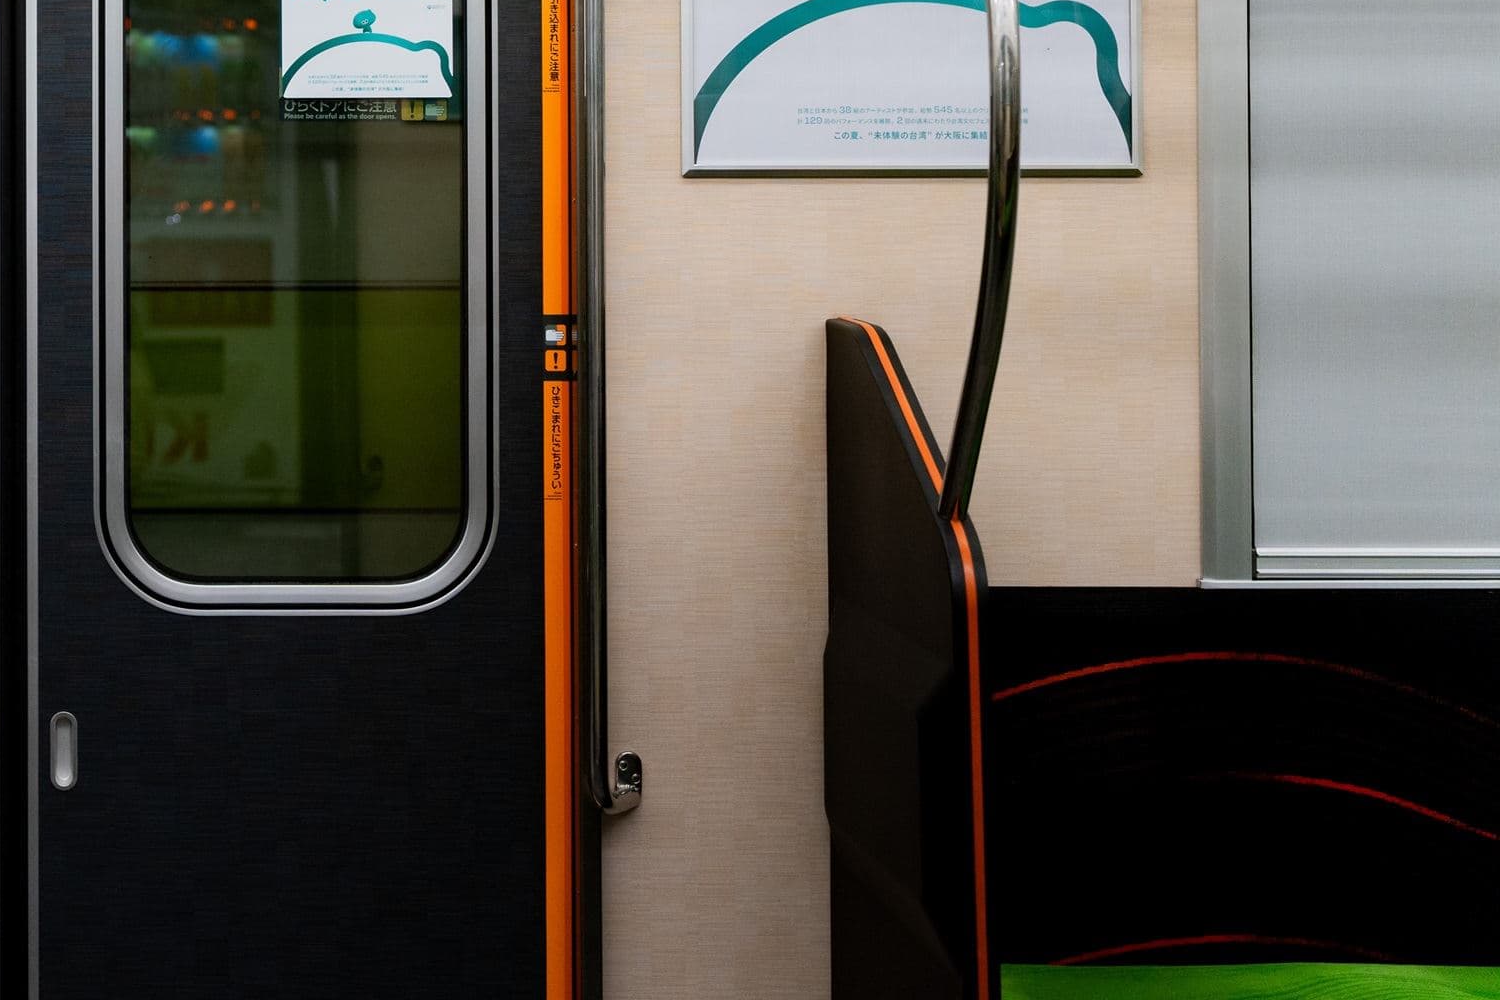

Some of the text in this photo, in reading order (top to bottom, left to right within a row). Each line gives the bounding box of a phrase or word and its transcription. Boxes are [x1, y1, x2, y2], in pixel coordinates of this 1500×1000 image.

[284, 100, 397, 113] ひらくドアにご注意
[376, 113, 397, 121] opens.
[551, 386, 562, 490] ひきこまれにごちゅうい
